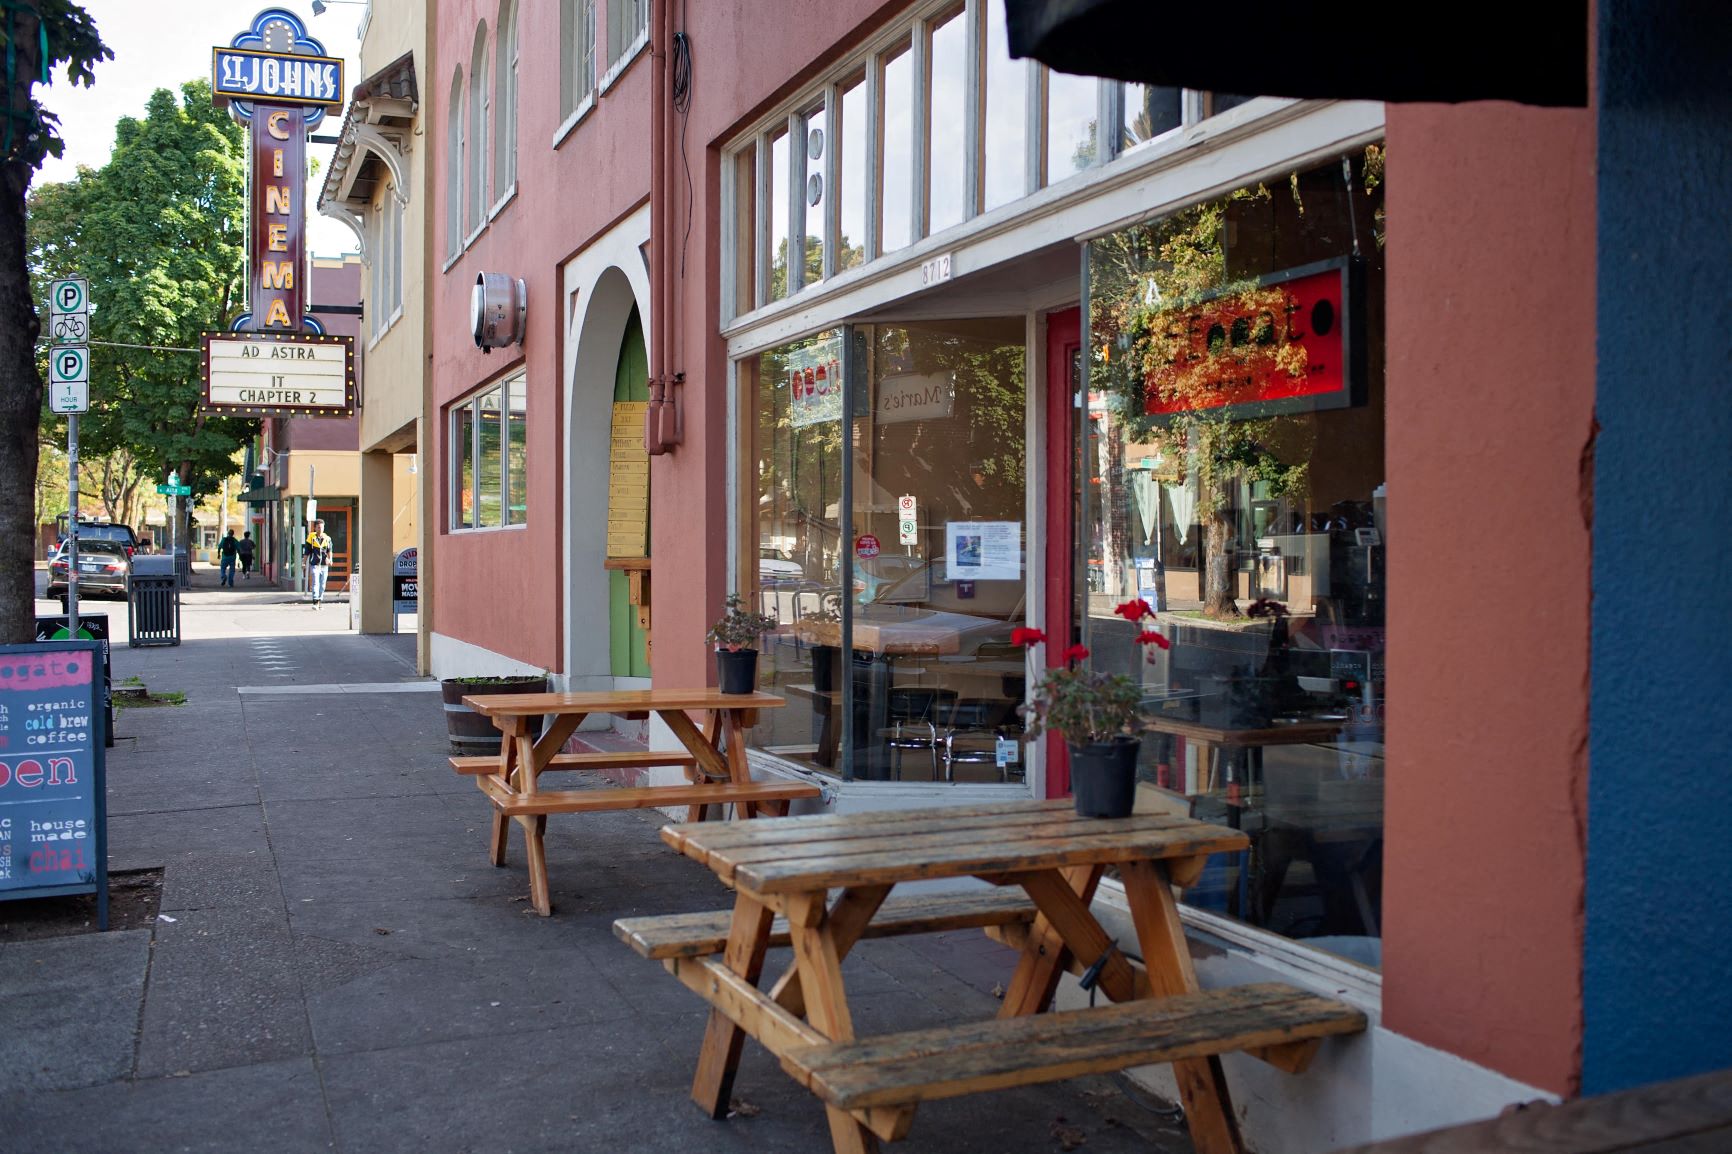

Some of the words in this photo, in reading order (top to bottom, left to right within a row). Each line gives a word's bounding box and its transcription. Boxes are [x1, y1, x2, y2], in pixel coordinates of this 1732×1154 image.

[243, 58, 336, 98] JOHNS
[262, 110, 294, 327] CINEMA
[922, 256, 949, 285] 8712
[64, 288, 77, 307] P
[242, 345, 260, 358] AD
[271, 346, 316, 360] ASTRA
[64, 356, 77, 375] P
[271, 375, 285, 388] IT
[66, 385, 72, 396] 1
[239, 389, 301, 403] CHAPTER
[309, 391, 317, 404] 2
[28, 699, 85, 712] organic
[25, 715, 54, 731] cold
[59, 713, 88, 729] brew
[26, 731, 87, 745] coffee
[30, 819, 86, 832] house
[31, 829, 87, 843] made
[30, 841, 87, 874] chai
